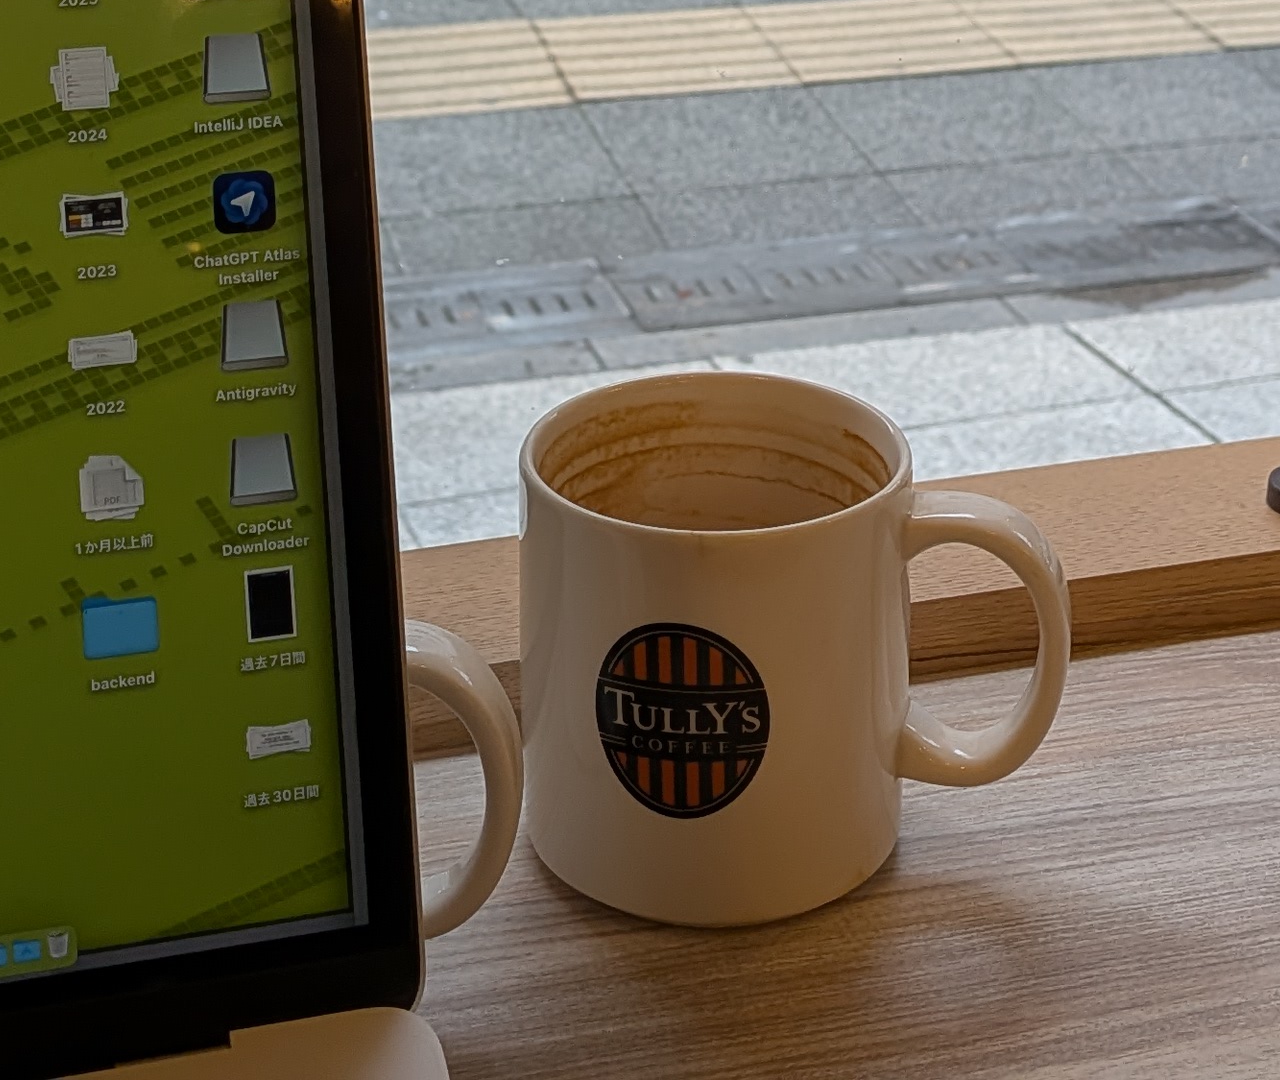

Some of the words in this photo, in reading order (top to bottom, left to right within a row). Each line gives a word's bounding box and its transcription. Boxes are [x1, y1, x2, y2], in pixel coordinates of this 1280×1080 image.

[193, 117, 245, 134] IntelliJ
[247, 115, 284, 130] IDEA
[67, 128, 108, 144] 2024
[193, 250, 259, 269] ChatGPT
[263, 248, 301, 262] Atlas
[77, 264, 117, 280] 2023
[218, 270, 279, 286] Installer
[215, 383, 297, 403] Antigravity
[86, 400, 126, 416] 2022
[237, 518, 293, 536] CapCut
[75, 534, 154, 556] 1か月以上前
[222, 536, 310, 557] Downloader
[91, 671, 155, 692] backend
[604, 686, 761, 735] TULLY'S
[631, 735, 732, 755] COFFEE
